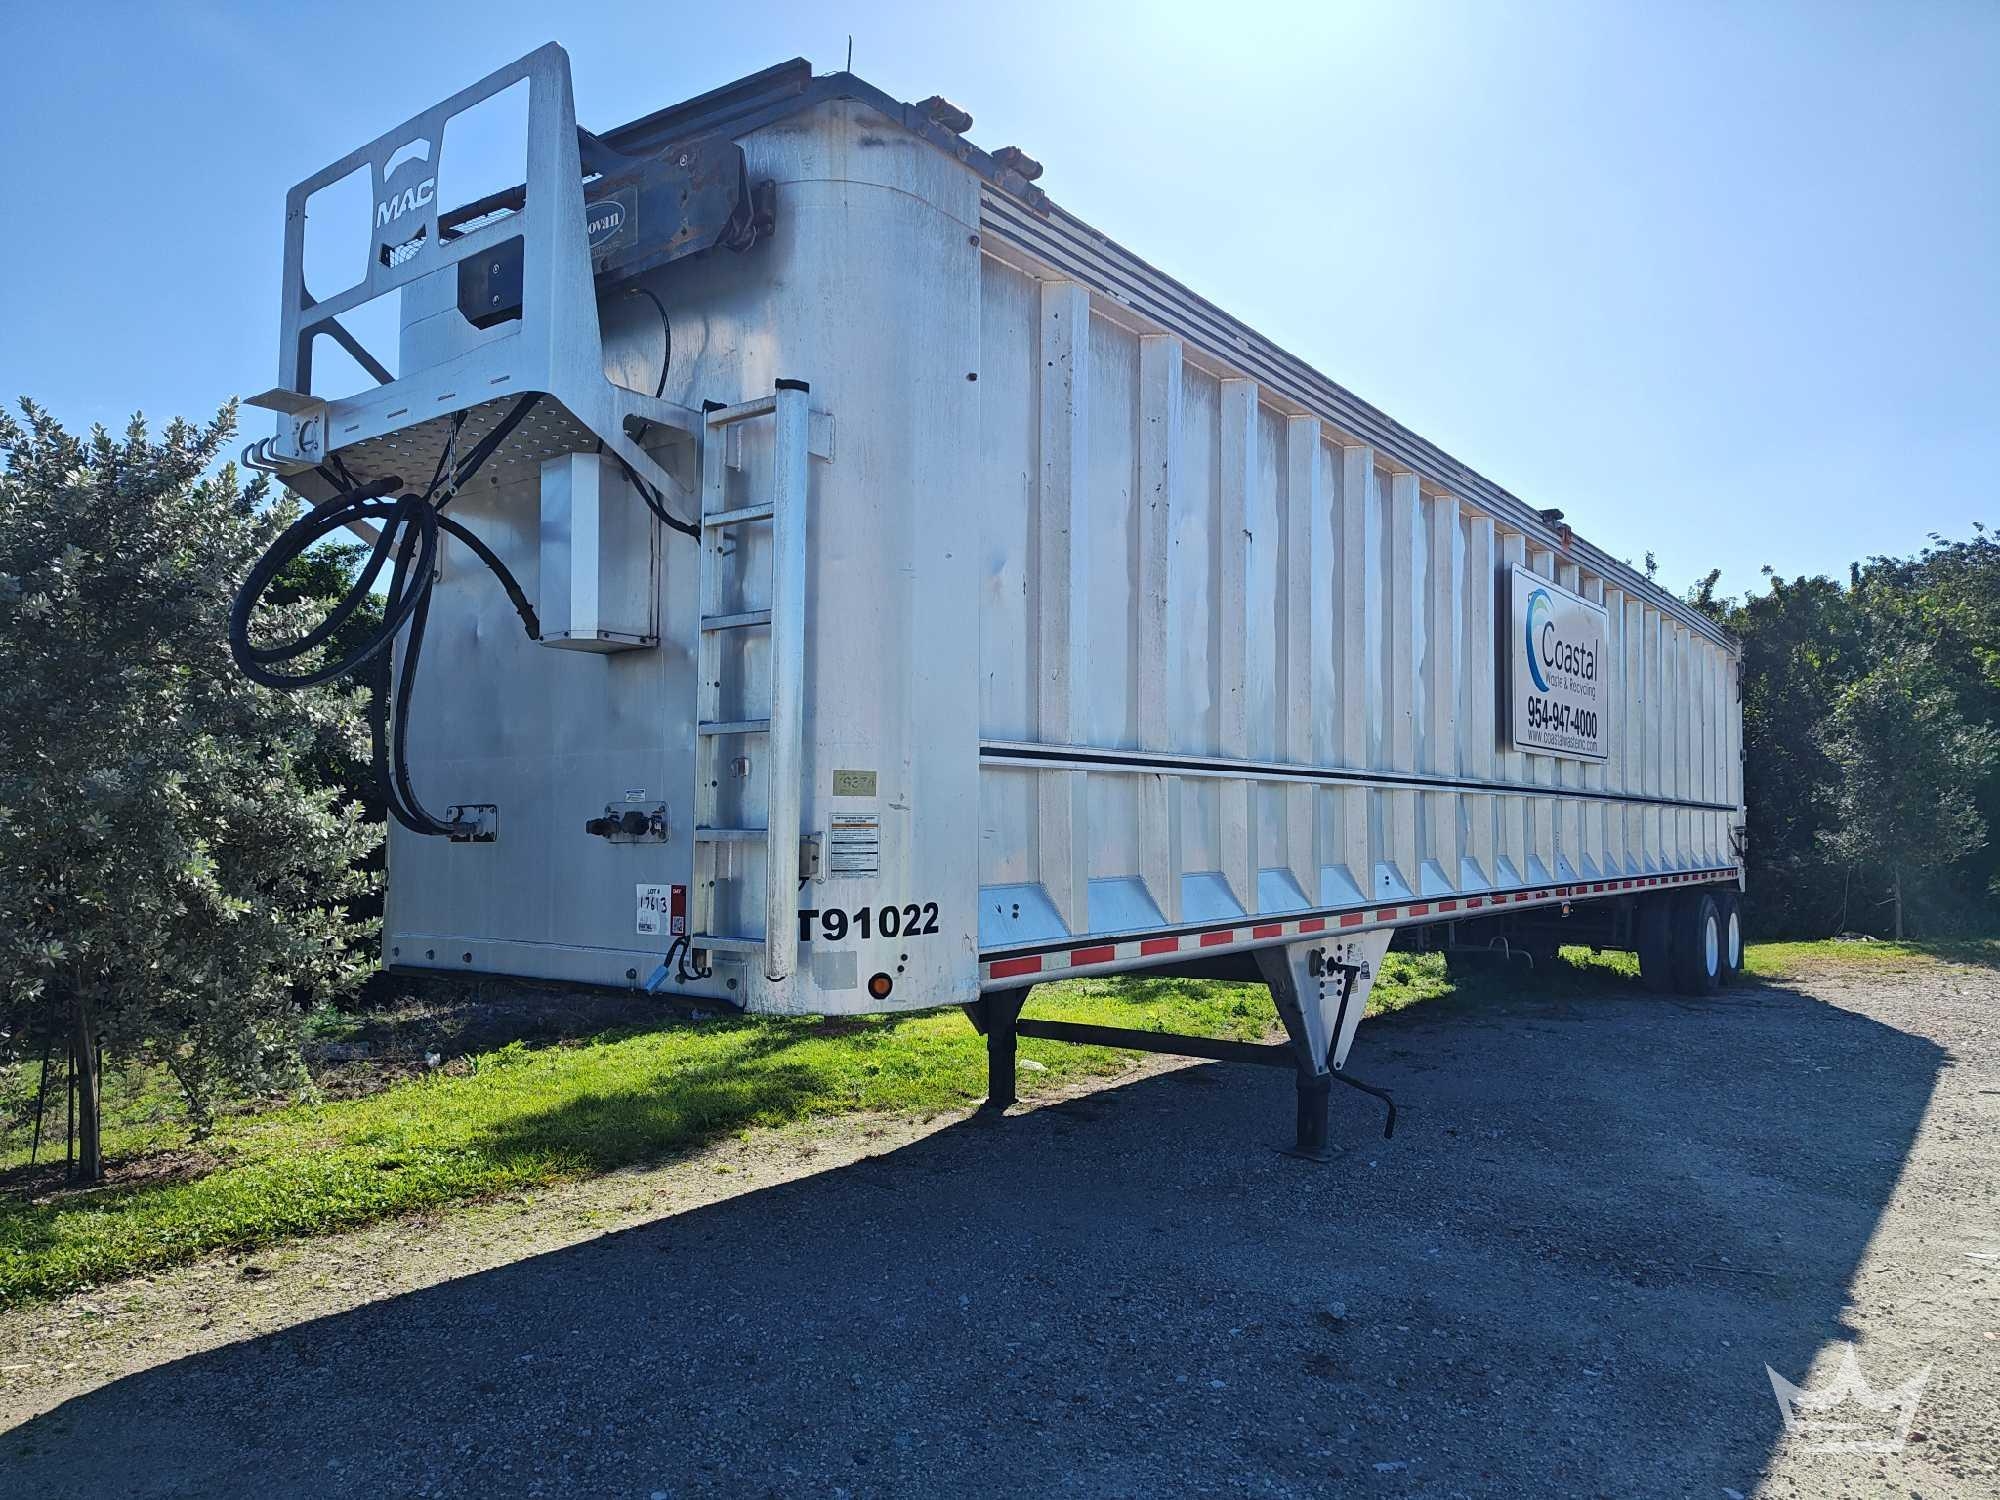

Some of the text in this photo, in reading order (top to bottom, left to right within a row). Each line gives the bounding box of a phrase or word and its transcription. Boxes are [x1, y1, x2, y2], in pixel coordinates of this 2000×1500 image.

[376, 178, 435, 229] MAC
[588, 212, 619, 234] ovan
[1542, 621, 1598, 681] Coastal
[1569, 678, 1596, 701] Recycling
[1528, 696, 1598, 739] 954-947-4000
[640, 896, 667, 913] 17613
[797, 902, 939, 942] T91022
